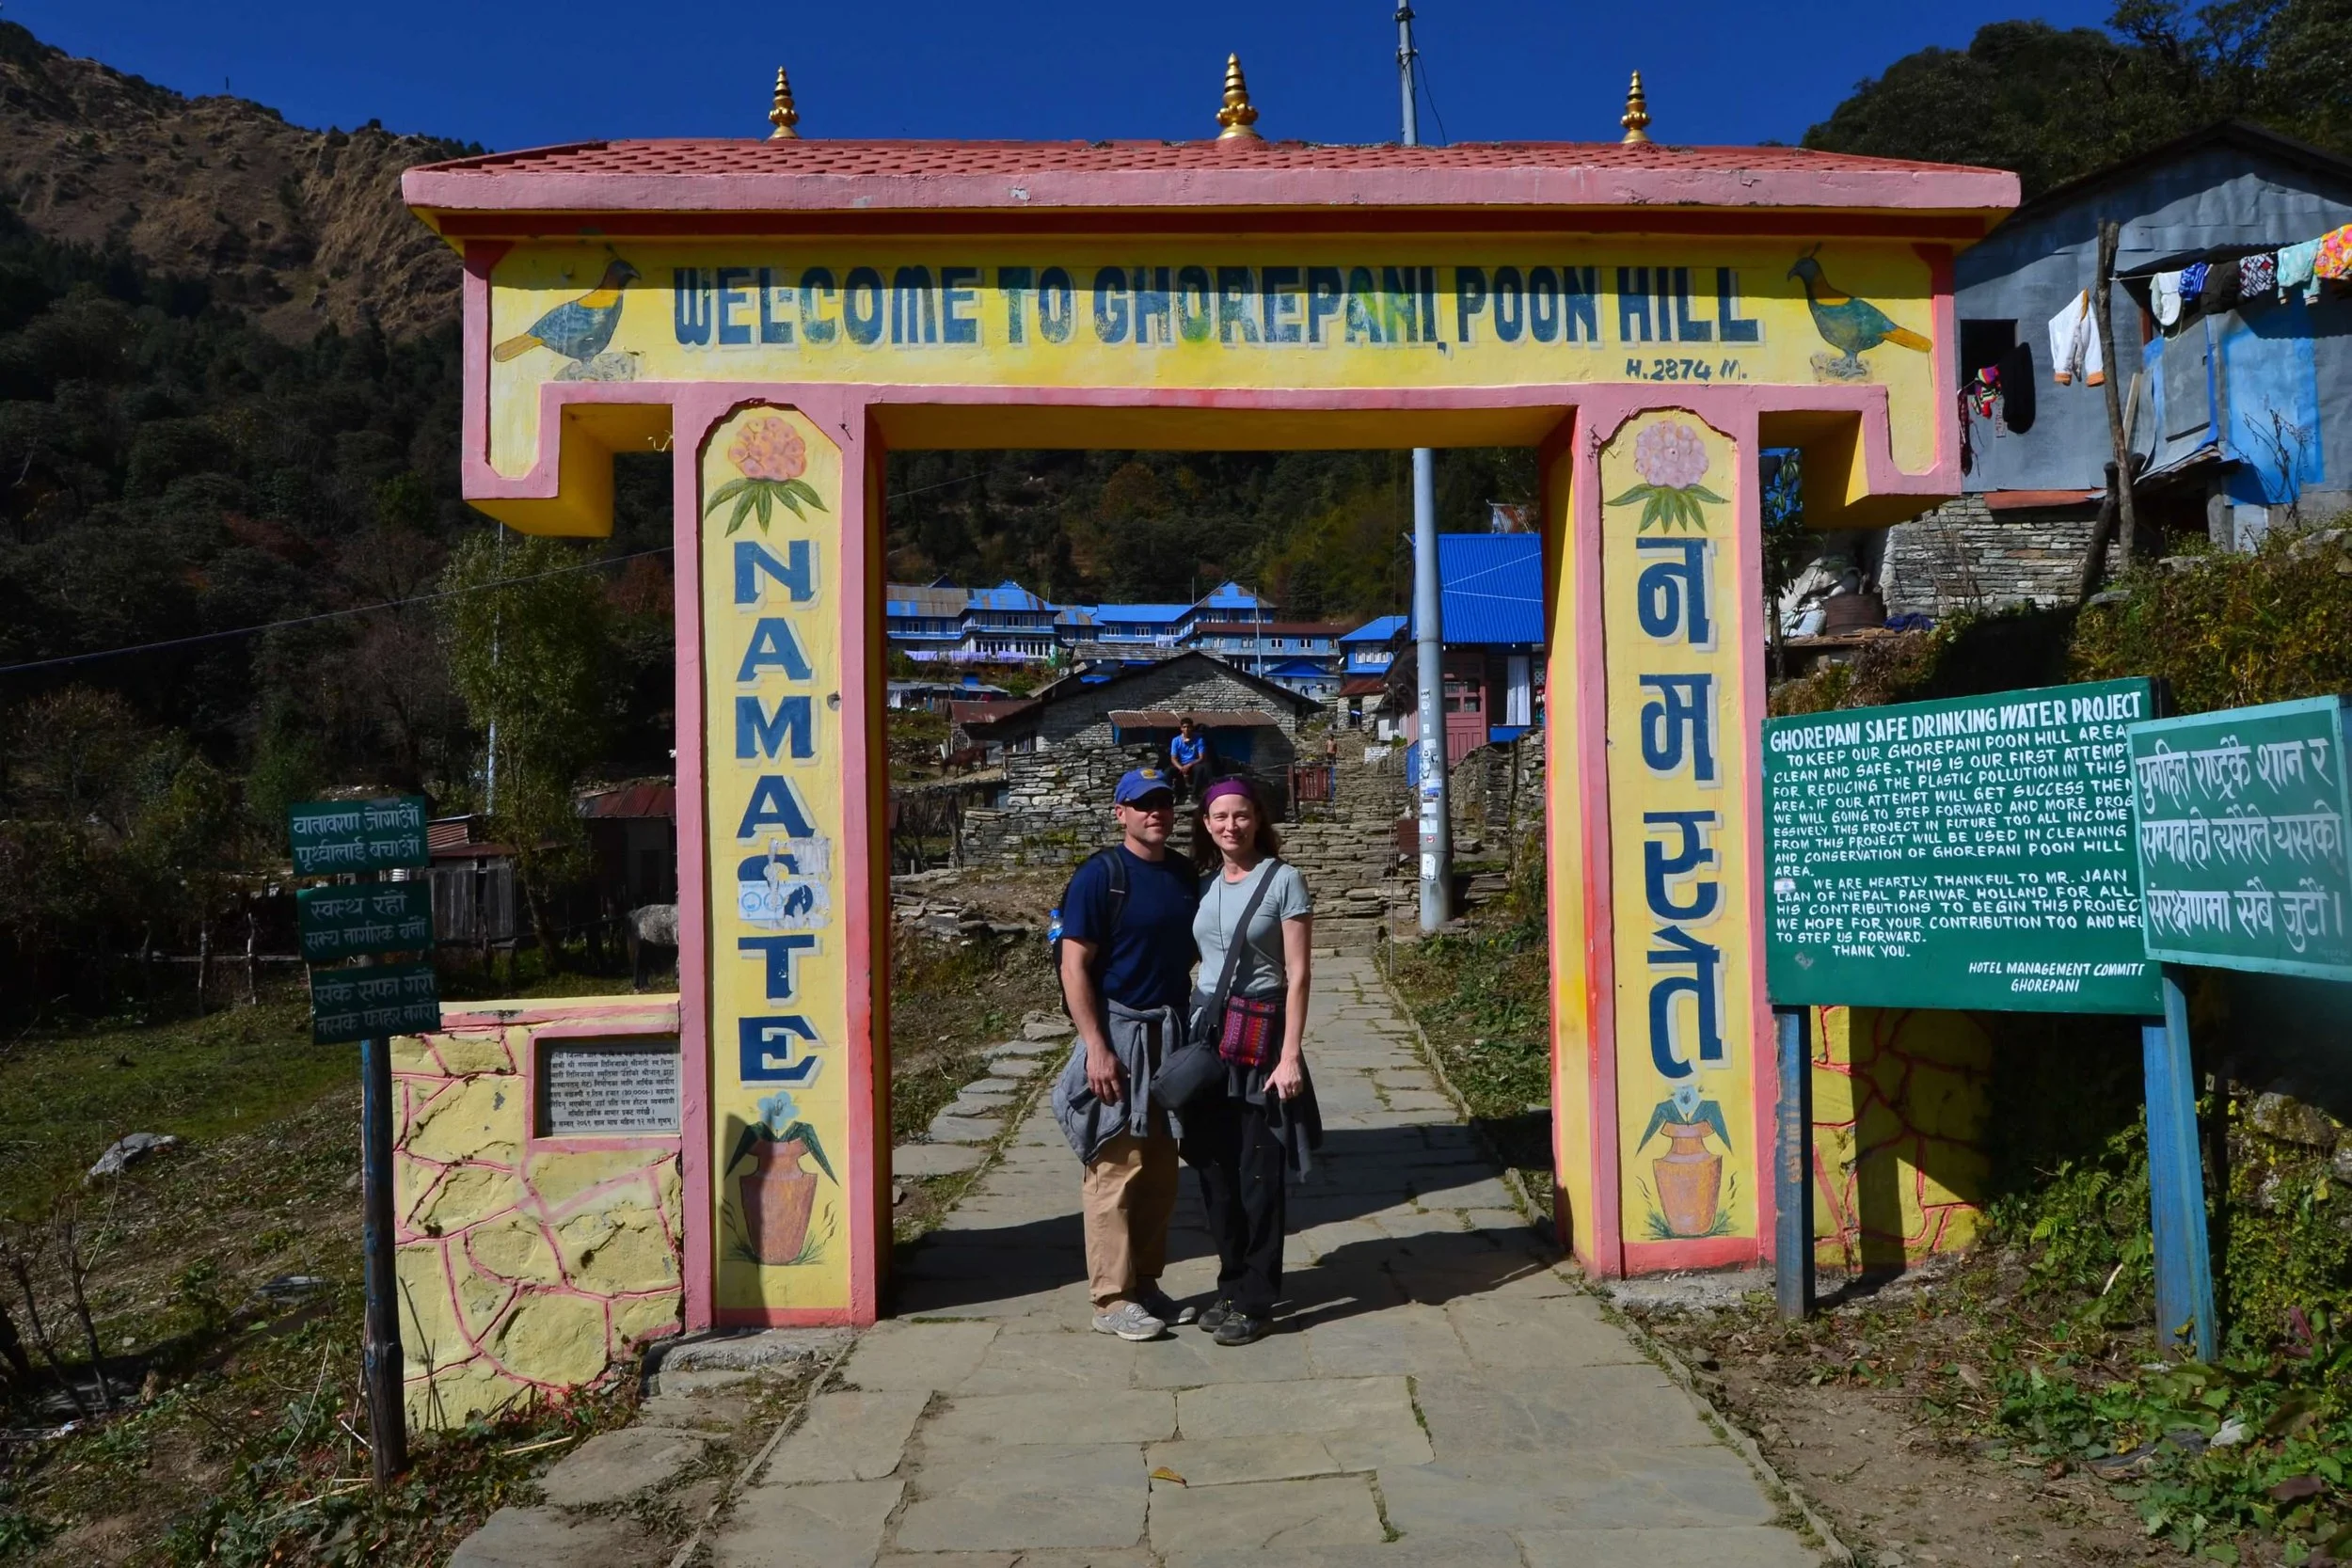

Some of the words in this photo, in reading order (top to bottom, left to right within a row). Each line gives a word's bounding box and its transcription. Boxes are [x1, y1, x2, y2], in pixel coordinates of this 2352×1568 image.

[674, 266, 984, 349] WELCOME
[998, 266, 1074, 348] TO
[1456, 266, 1602, 349] POON
[1615, 267, 1762, 350] HILL
[1770, 721, 1861, 752] GHOREPANI
[1865, 716, 1909, 743] SAFE
[1912, 707, 1998, 739] DRINKING
[1999, 699, 2069, 731] WATER
[2071, 690, 2141, 724] PROJECT
[1786, 753, 1804, 768] TO
[1805, 750, 1847, 767] KEEP
[1851, 746, 1883, 761] OUR
[1887, 736, 1980, 759] GHOREPANI
[1985, 732, 2029, 751] POON
[2034, 729, 2072, 746] HILL
[2078, 723, 2127, 741] AREA
[1773, 768, 1818, 784] CLEAN
[1823, 766, 1850, 781] AND
[1904, 757, 1943, 773] THIS
[1948, 755, 1964, 770] IS
[1970, 752, 2006, 768] OUR
[2009, 749, 2057, 766] FIRST
[2064, 743, 2127, 762] ATTEMP
[2256, 741, 2306, 795] शान
[2307, 737, 2333, 786] र
[1772, 785, 1801, 798] FOR
[1806, 778, 1878, 797] REDUCING
[1883, 776, 1911, 790] THE
[1917, 771, 1973, 788] PLASTIC
[1979, 764, 2059, 784] POLLUTION
[2062, 764, 2077, 777] IN
[2084, 759, 2127, 775] THIS
[1816, 798, 1828, 810] IF
[1835, 796, 1865, 809] OUR
[1867, 791, 1929, 806] ATTEMPT
[1934, 789, 1967, 802] WILL
[1973, 785, 2007, 801] GET
[2012, 780, 2084, 798] SUCCESS
[1773, 814, 1792, 825] WE
[1799, 812, 1825, 825] WILL
[1831, 809, 1869, 824] GOING
[1873, 808, 1889, 820] TO
[1895, 805, 1931, 818] STEP
[1935, 801, 2003, 817] FORWARD
[2009, 800, 2039, 814] AND
[2044, 797, 2087, 812] MORE
[1773, 825, 1828, 837] ESSIVELY
[1833, 824, 1859, 835] THIS
[1862, 820, 1920, 834] PROJECT
[1925, 819, 1939, 832] IN
[1946, 816, 1996, 830] FUTURE
[2003, 814, 2031, 827] TOO
[2037, 812, 2061, 824] ALL
[2067, 808, 2128, 823] INCOME
[293, 813, 361, 835] वातावरण
[1773, 839, 1810, 850] FROM
[1815, 837, 1844, 848] THIS
[1849, 833, 1906, 851] PROJECT
[1912, 832, 1943, 845] WILL
[1947, 832, 1967, 844] BE
[1975, 829, 2017, 843] USED
[2025, 828, 2041, 841] IN
[2046, 824, 2127, 840] CLEANING
[1774, 852, 1798, 863] AND
[1804, 847, 1902, 863] CONSERVATION
[1907, 847, 1927, 859] OF
[1932, 844, 2021, 858] GHOREPANI
[2028, 841, 2074, 857] POON
[2083, 840, 2125, 852] HILL
[1774, 864, 1815, 877] AREA.
[1813, 879, 1833, 890] WE
[1838, 878, 1863, 890] ARE
[1868, 876, 1928, 888] HEARTLY
[1933, 874, 2014, 886] THANKFUL
[2017, 873, 2039, 884] TO
[2045, 871, 2074, 884] MR.
[2080, 868, 2127, 883] JAAN
[1777, 891, 1810, 903] LAAN
[1817, 891, 1836, 902] OF
[1842, 890, 1890, 901] NEPAL
[1899, 888, 1970, 901] PARIWAR
[1976, 886, 2048, 899] HOLLAND
[2056, 885, 2092, 899] FOR
[2100, 885, 2135, 897] ALL
[1776, 904, 1801, 915] HIS
[1808, 902, 1931, 916] CONTRIBUTIONS
[1939, 901, 1964, 913] TO
[1972, 899, 2026, 913] BEGIN
[2031, 898, 2069, 912] THIS
[2073, 898, 2139, 912] PROJEC
[1776, 917, 1799, 930] WE
[1804, 917, 1844, 930] HOPE
[1851, 917, 1883, 930] FOR
[1885, 916, 1925, 930] YOUR
[1929, 915, 2042, 929] CONTRIBUTION
[2044, 914, 2077, 929] TOO
[2086, 914, 2115, 928] AND
[1775, 932, 1793, 942] TO
[1797, 931, 1832, 943] STEP
[1836, 931, 1853, 943] US
[1858, 930, 1927, 943] FORWARD.
[1832, 943, 1876, 958] THANK
[1879, 944, 1911, 958] YOU.
[1968, 961, 2003, 974] HOTEL
[2006, 961, 2091, 977] MANAGEMENT
[2010, 977, 2080, 993] GHOREPANI
